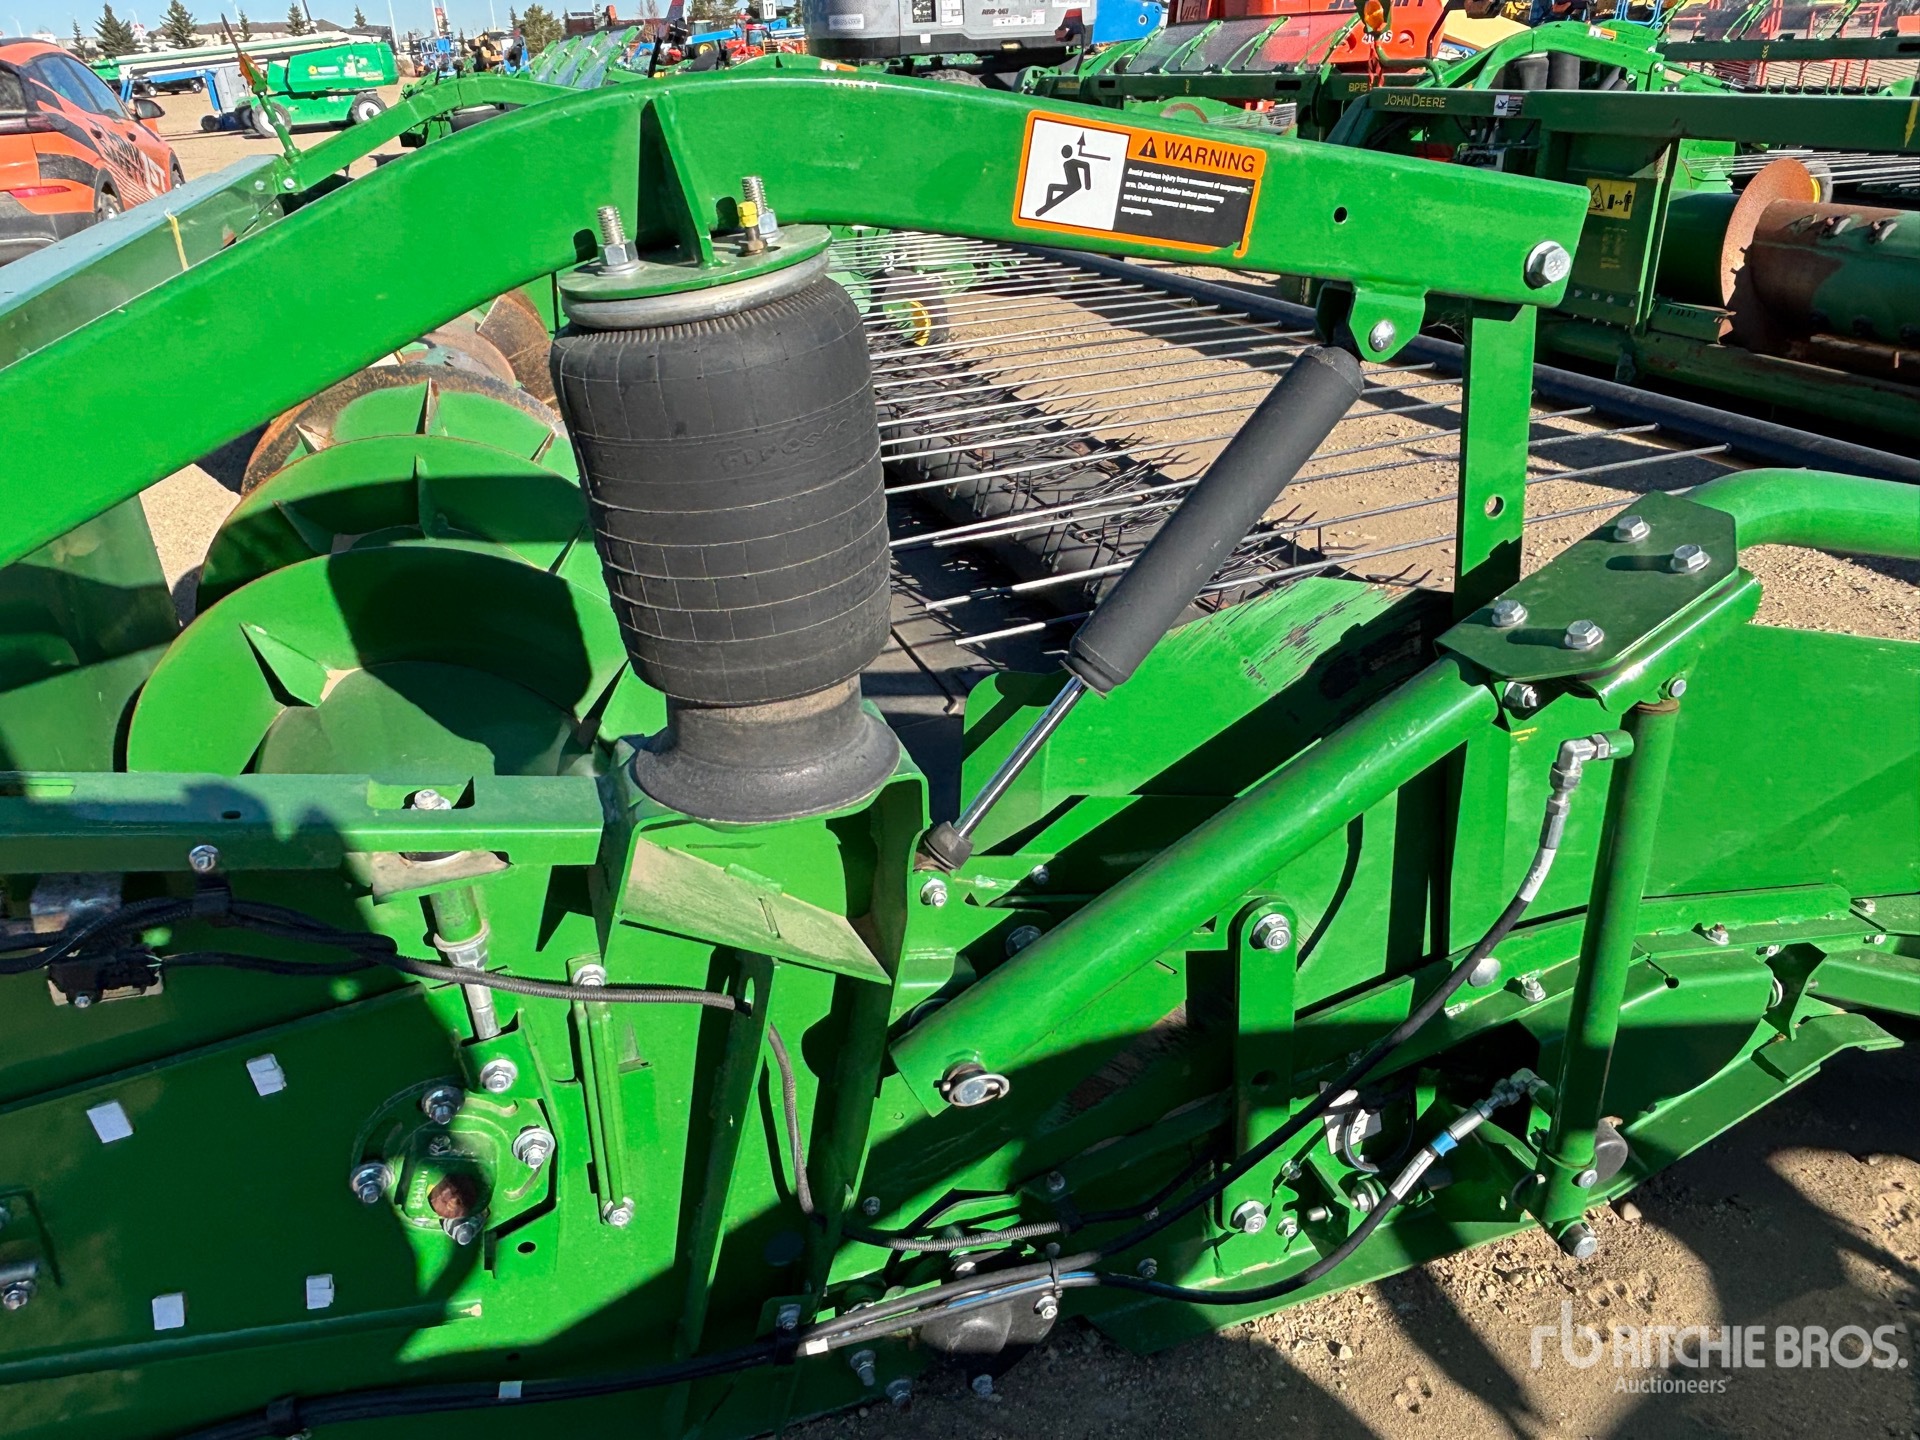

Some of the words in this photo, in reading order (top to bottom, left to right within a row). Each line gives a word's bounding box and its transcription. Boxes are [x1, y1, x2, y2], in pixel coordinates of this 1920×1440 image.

[1384, 93, 1411, 106] JOHN
[1411, 93, 1446, 108] DEERE
[1164, 140, 1256, 173] WARNING
